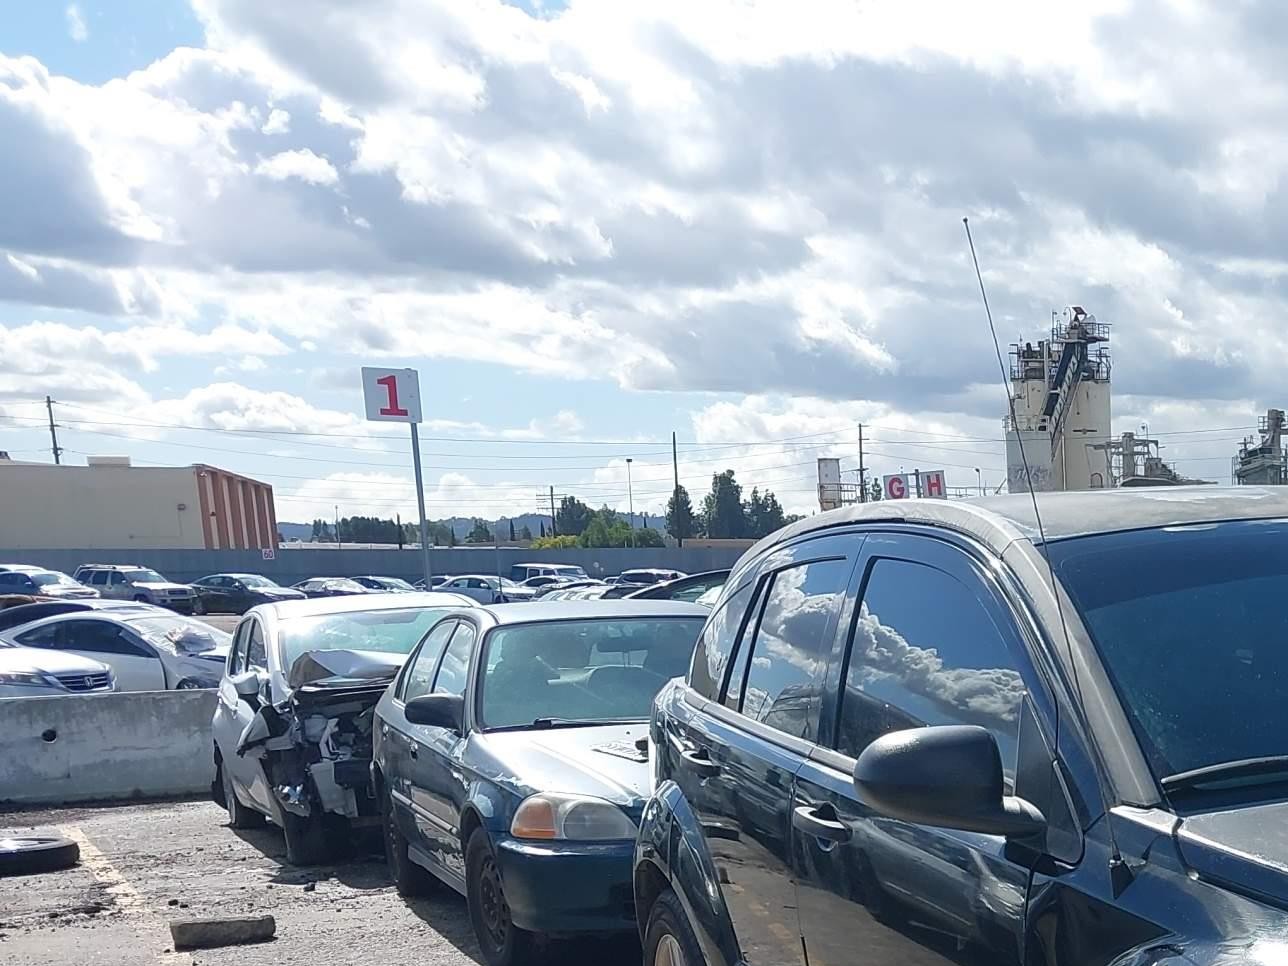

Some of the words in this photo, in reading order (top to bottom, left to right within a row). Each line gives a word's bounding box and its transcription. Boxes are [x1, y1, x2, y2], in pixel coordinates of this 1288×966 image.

[377, 375, 408, 416] 1
[888, 477, 905, 499] G
[926, 474, 942, 497] H
[264, 550, 273, 559] 60
